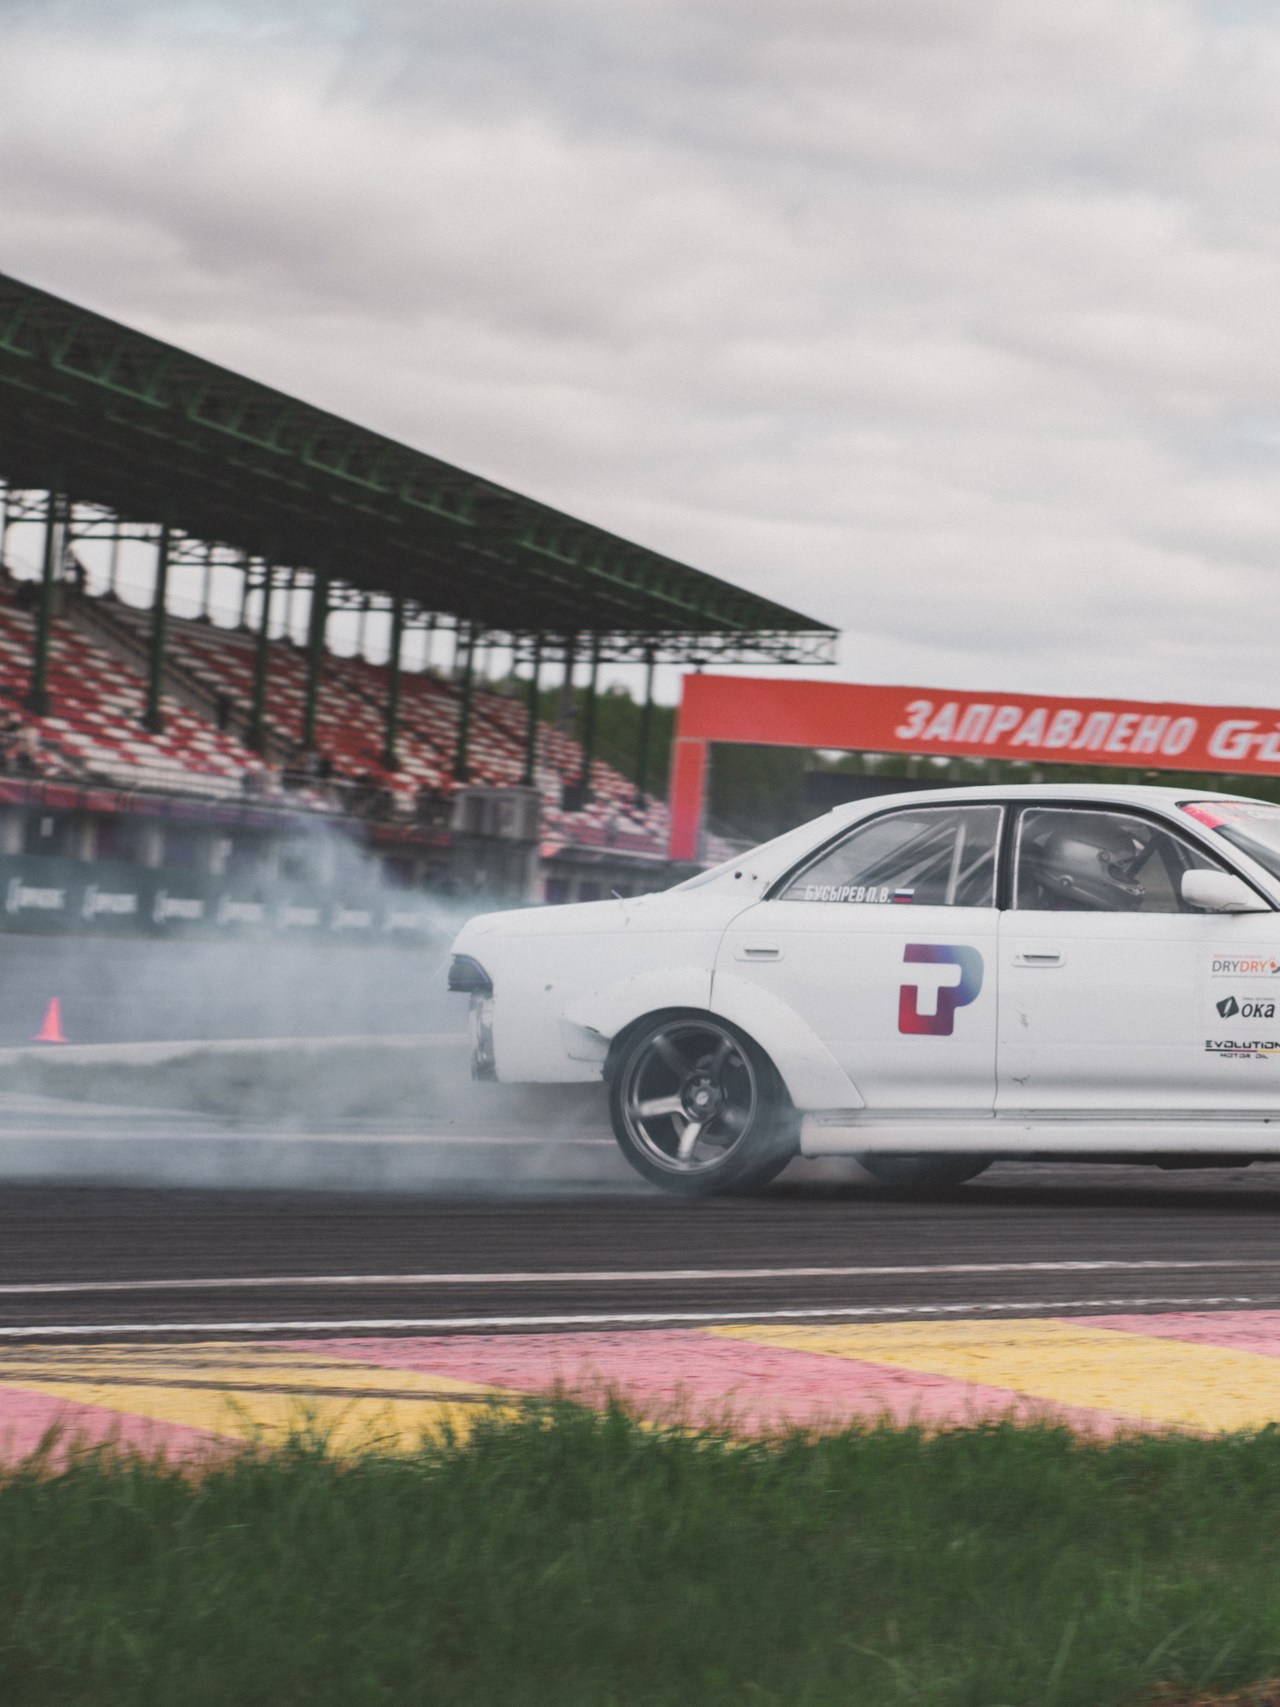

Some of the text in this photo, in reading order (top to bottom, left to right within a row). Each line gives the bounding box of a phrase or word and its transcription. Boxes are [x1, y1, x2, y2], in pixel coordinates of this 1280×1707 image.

[895, 700, 1198, 757] ЗАПРАВЛЕНО
[804, 885, 866, 902] БУСЫРЕВ
[1212, 960, 1267, 973] DRYDRY
